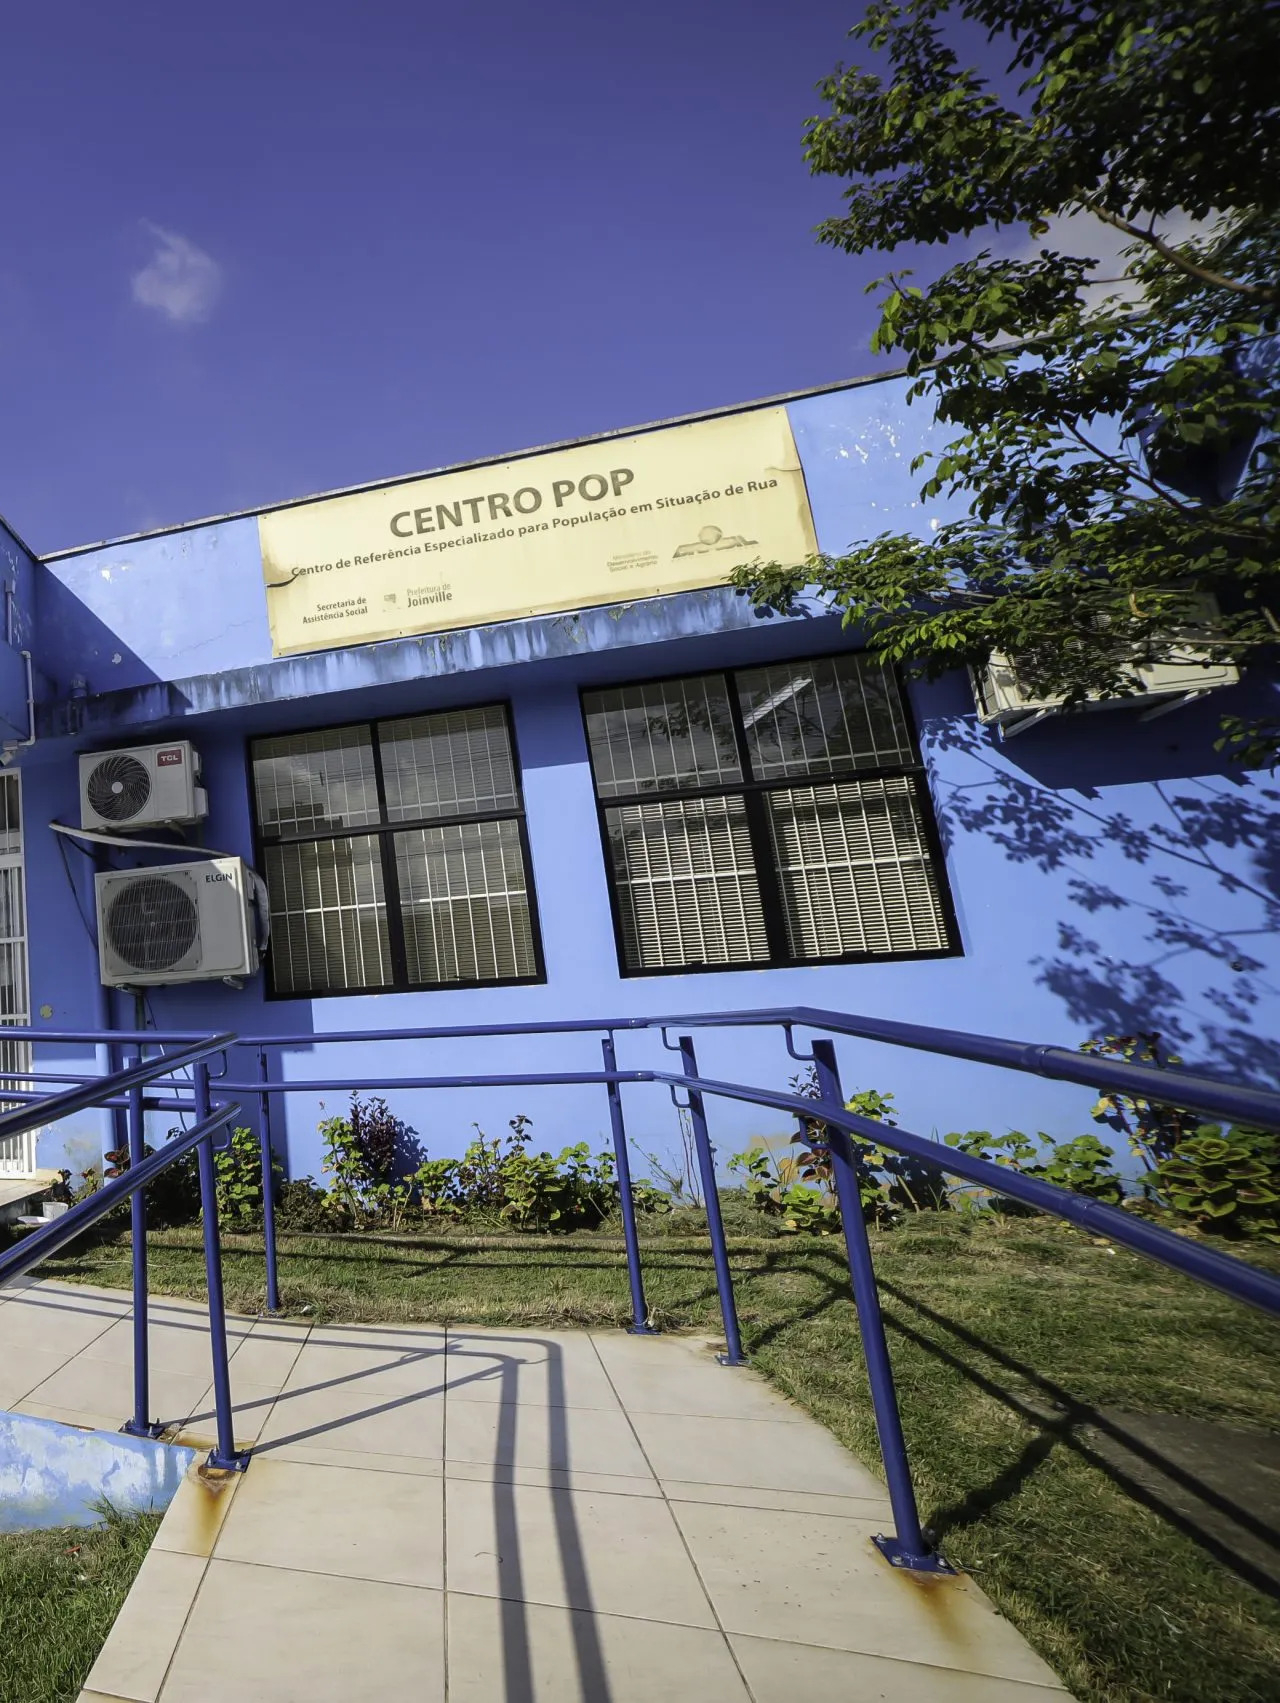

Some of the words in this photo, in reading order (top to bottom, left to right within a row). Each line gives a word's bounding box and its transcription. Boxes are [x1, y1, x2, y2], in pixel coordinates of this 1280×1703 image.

[390, 487, 542, 538] CENTRO
[552, 468, 635, 508] POP
[291, 562, 333, 577] Centro
[336, 558, 351, 570] de
[354, 545, 421, 566] Referência
[424, 527, 514, 553] Especializado
[518, 521, 549, 537] para
[552, 505, 626, 530] População
[630, 503, 653, 515] em
[655, 489, 721, 510] Situação
[725, 484, 744, 497] de
[747, 478, 778, 493] Rua
[316, 599, 356, 612] Secretaria
[357, 597, 367, 605] de
[407, 591, 453, 608] Joinville
[302, 612, 344, 625] Assistência
[345, 606, 368, 618] Social
[160, 754, 179, 762] TCL
[205, 872, 233, 883] ELGIN
